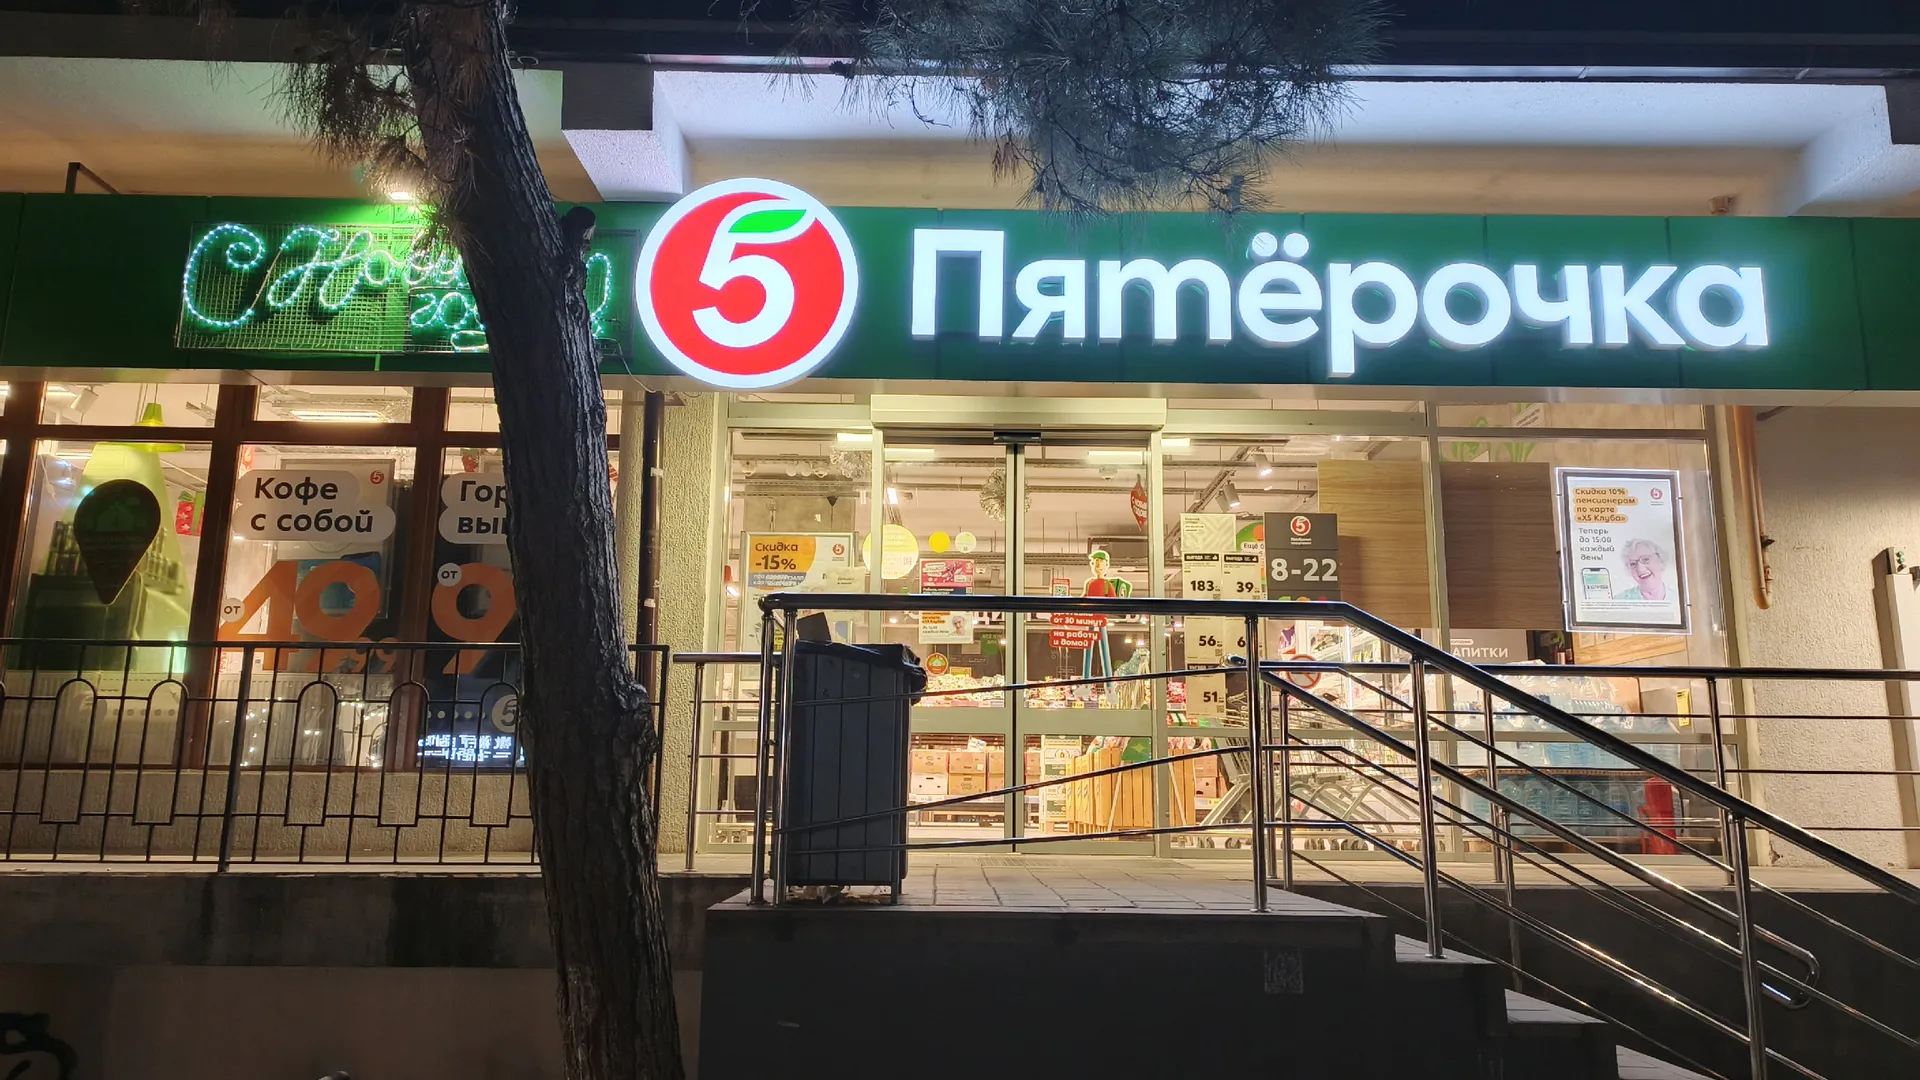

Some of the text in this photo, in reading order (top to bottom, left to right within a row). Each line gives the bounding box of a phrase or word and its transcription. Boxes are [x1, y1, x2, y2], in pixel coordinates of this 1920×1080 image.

[911, 228, 1769, 377] Пятёрочка
[254, 476, 338, 506] Кофе
[460, 480, 507, 509] Гор
[1575, 488, 1606, 496] Скидка
[250, 508, 374, 532] с собой
[457, 516, 507, 534] вы
[1579, 528, 1609, 536] Теперь
[755, 541, 799, 552] Скидка
[1580, 545, 1615, 553] каждый
[755, 554, 797, 570] -15%
[1580, 553, 1604, 561] день!
[441, 570, 458, 579] от
[1271, 558, 1338, 582] 8-22
[1190, 580, 1215, 591] 183
[1236, 581, 1254, 593] 39
[1065, 616, 1075, 624] 30
[1076, 619, 1103, 627] минут
[1066, 630, 1098, 640] работу
[1199, 635, 1217, 646] 56
[1060, 638, 1088, 647] домой
[1237, 636, 1246, 647] 6
[1453, 647, 1509, 658] АПИТКИ
[1203, 691, 1218, 703] 51
